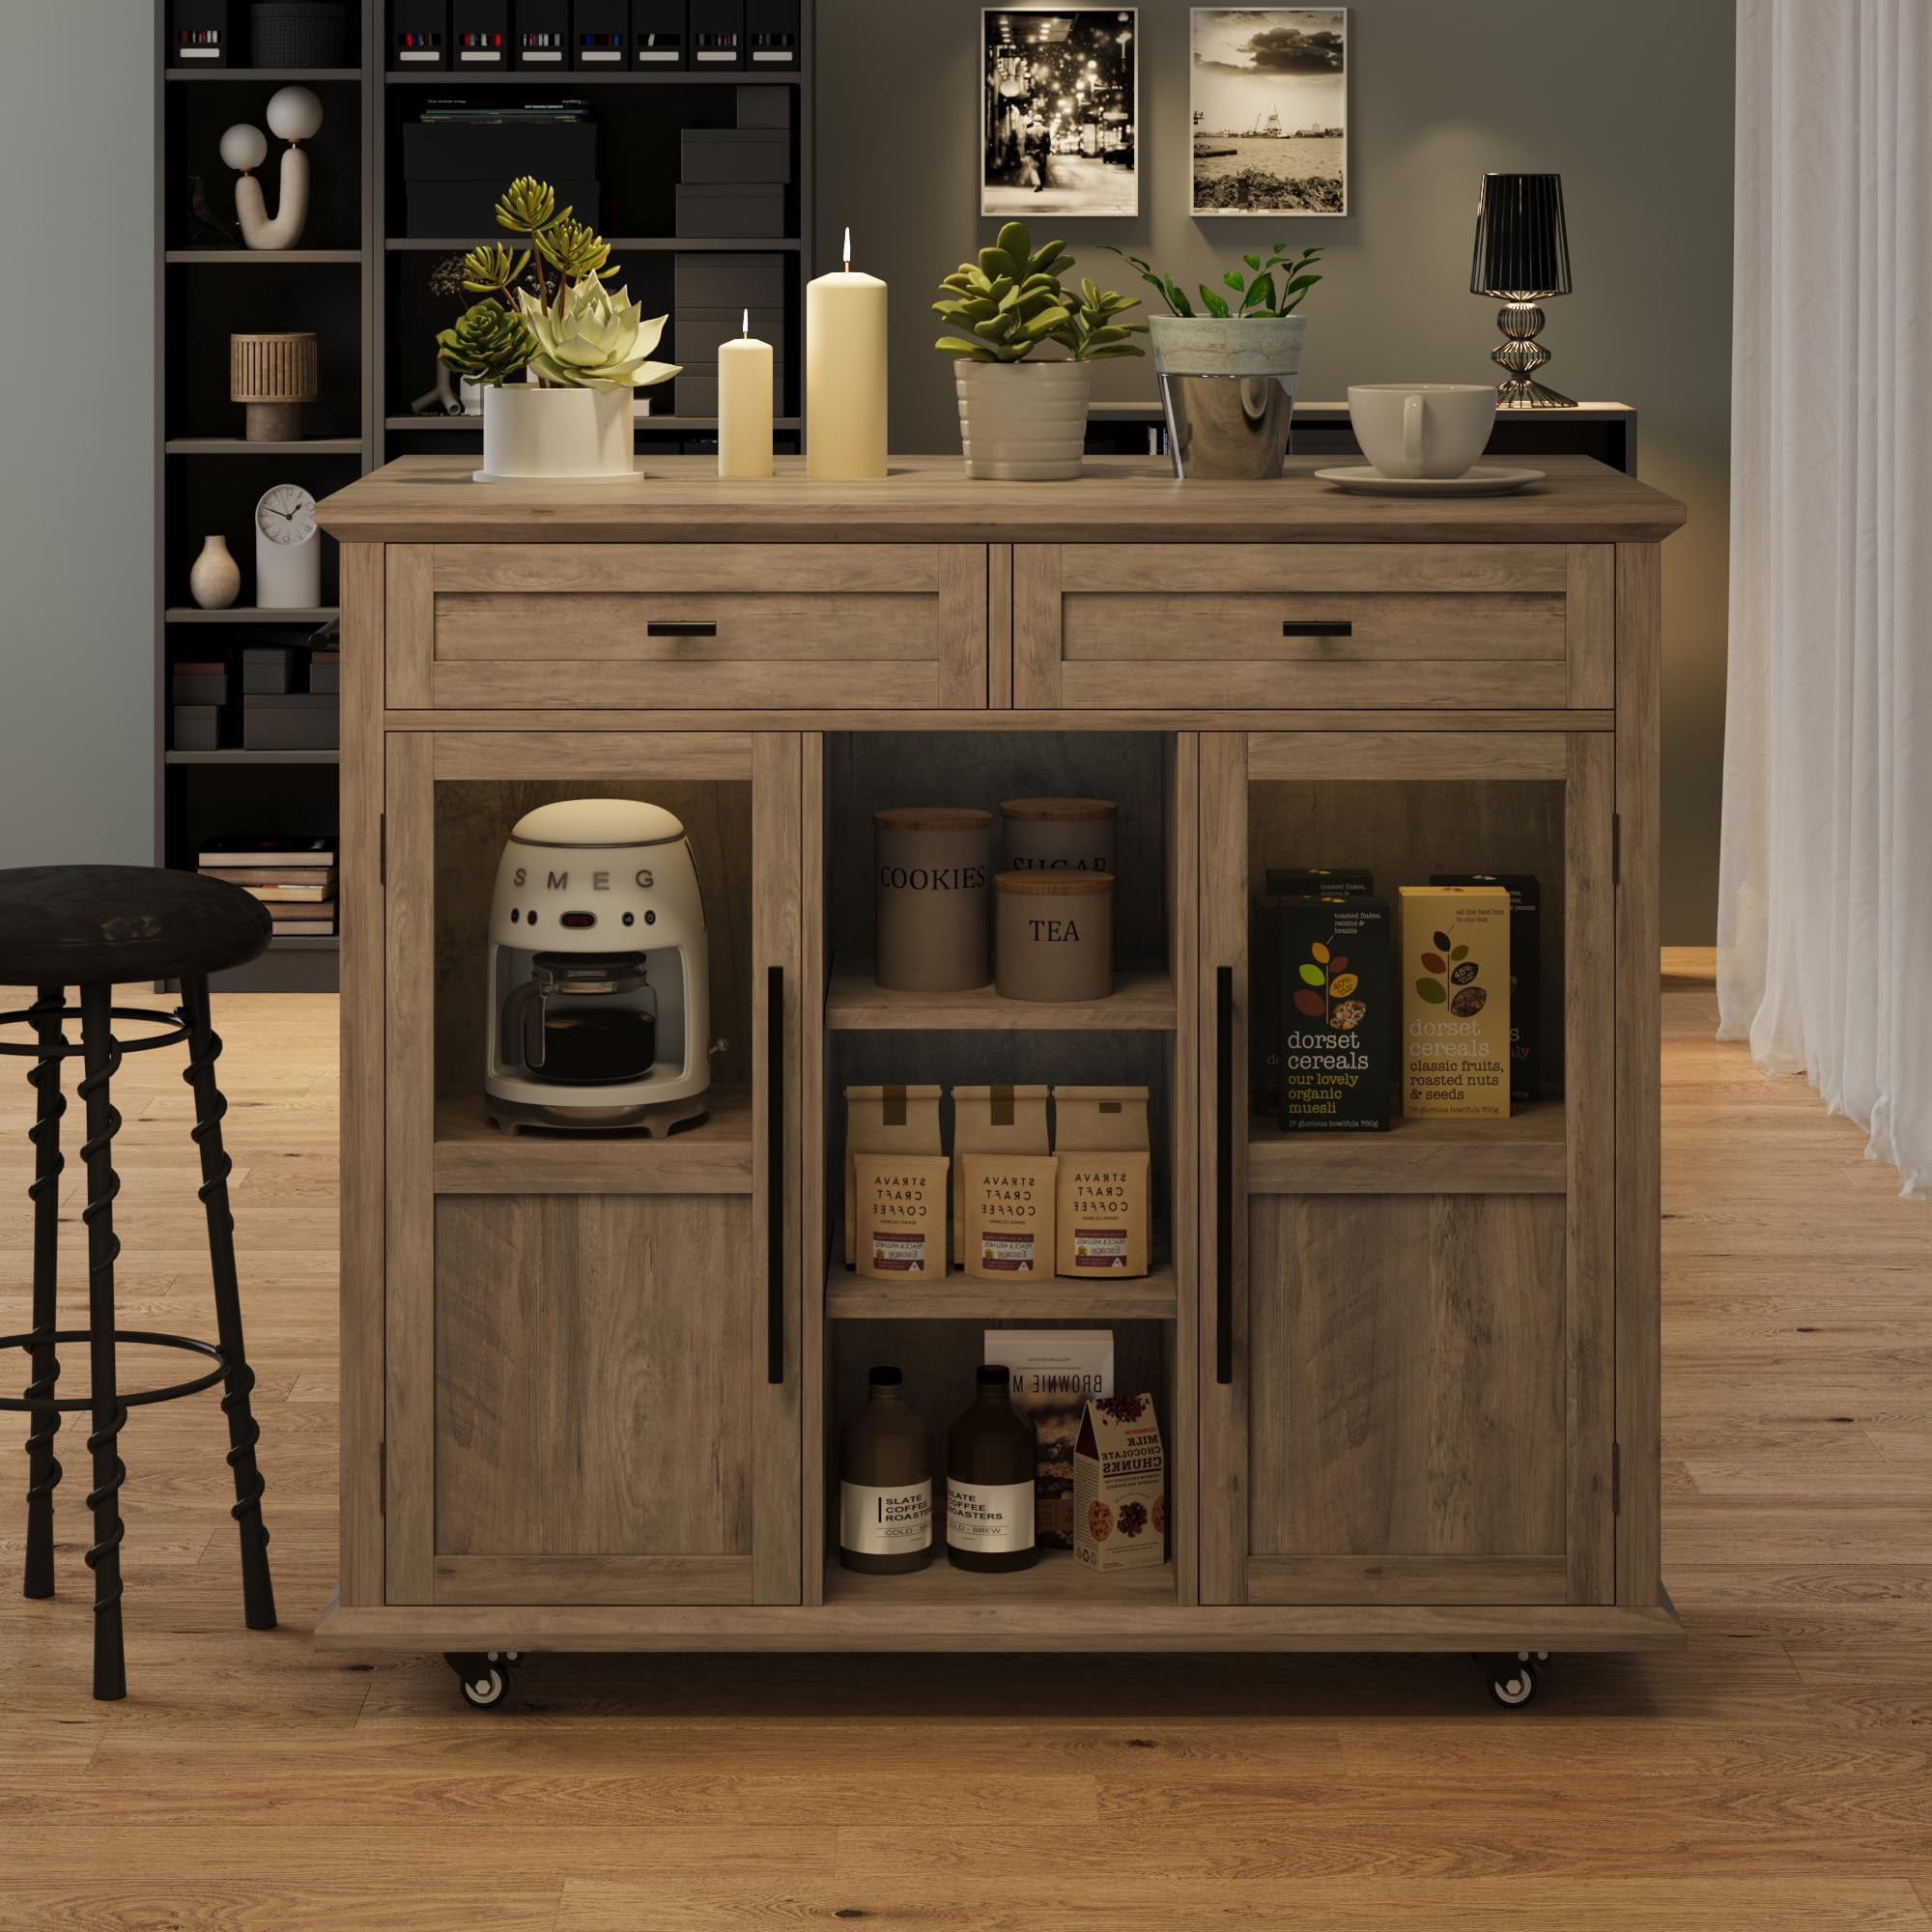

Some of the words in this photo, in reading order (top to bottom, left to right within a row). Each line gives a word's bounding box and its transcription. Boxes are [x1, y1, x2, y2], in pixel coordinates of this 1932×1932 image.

[512, 867, 655, 891] SMEG
[881, 865, 985, 891] COOKIES
[1029, 920, 1081, 942] TEA
[1409, 1019, 1481, 1037] dorset
[1288, 1031, 1360, 1050] dorset
[1409, 1038, 1490, 1056] cereals
[1288, 1052, 1369, 1069] cereals
[1410, 1060, 1458, 1071] classic
[1461, 1060, 1504, 1073] fruits,
[1288, 1075, 1314, 1086] our
[1316, 1073, 1359, 1088] lovely
[1410, 1074, 1463, 1086] roasted
[1466, 1075, 1499, 1086] nuts
[1288, 1088, 1343, 1101] organic
[1409, 1089, 1423, 1100] &
[1425, 1089, 1464, 1100] seeds
[1288, 1101, 1337, 1114] muesli
[886, 1493, 923, 1505] SLATE
[886, 1500, 928, 1514] COFFEE
[886, 1507, 932, 1521] ROASTE
